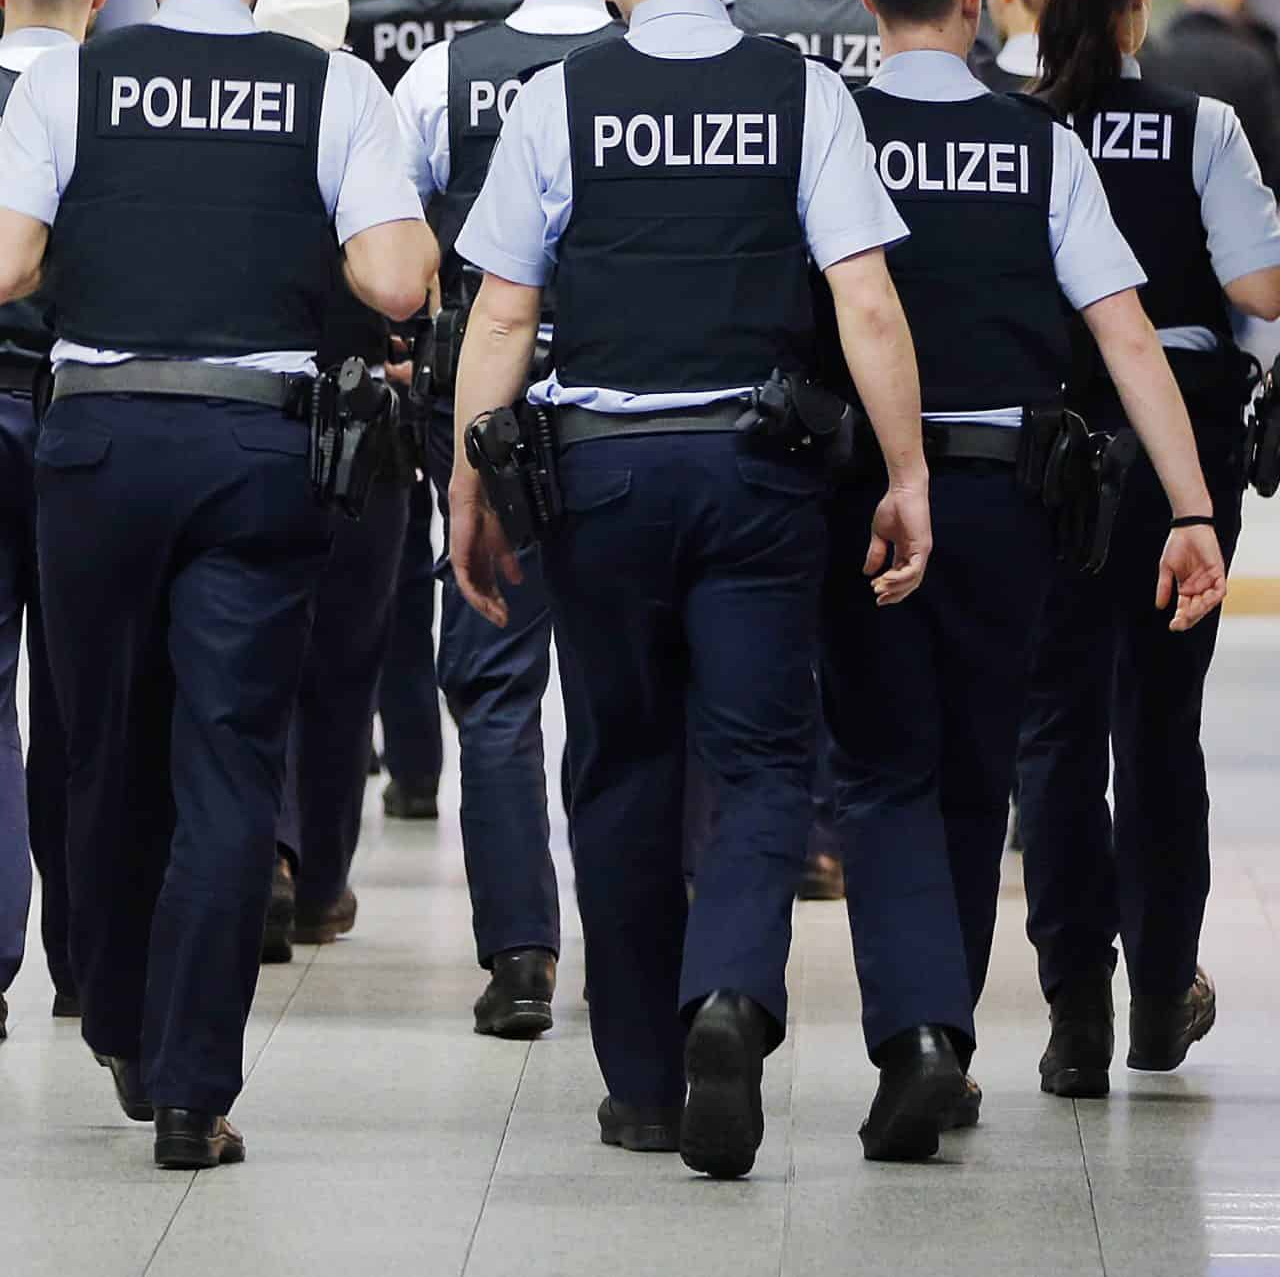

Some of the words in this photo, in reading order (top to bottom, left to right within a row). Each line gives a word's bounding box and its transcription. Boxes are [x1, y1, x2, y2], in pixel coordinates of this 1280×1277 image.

[110, 76, 296, 133] POLIZEI
[593, 113, 778, 168] POLIZEI
[1067, 111, 1172, 160] IZEI
